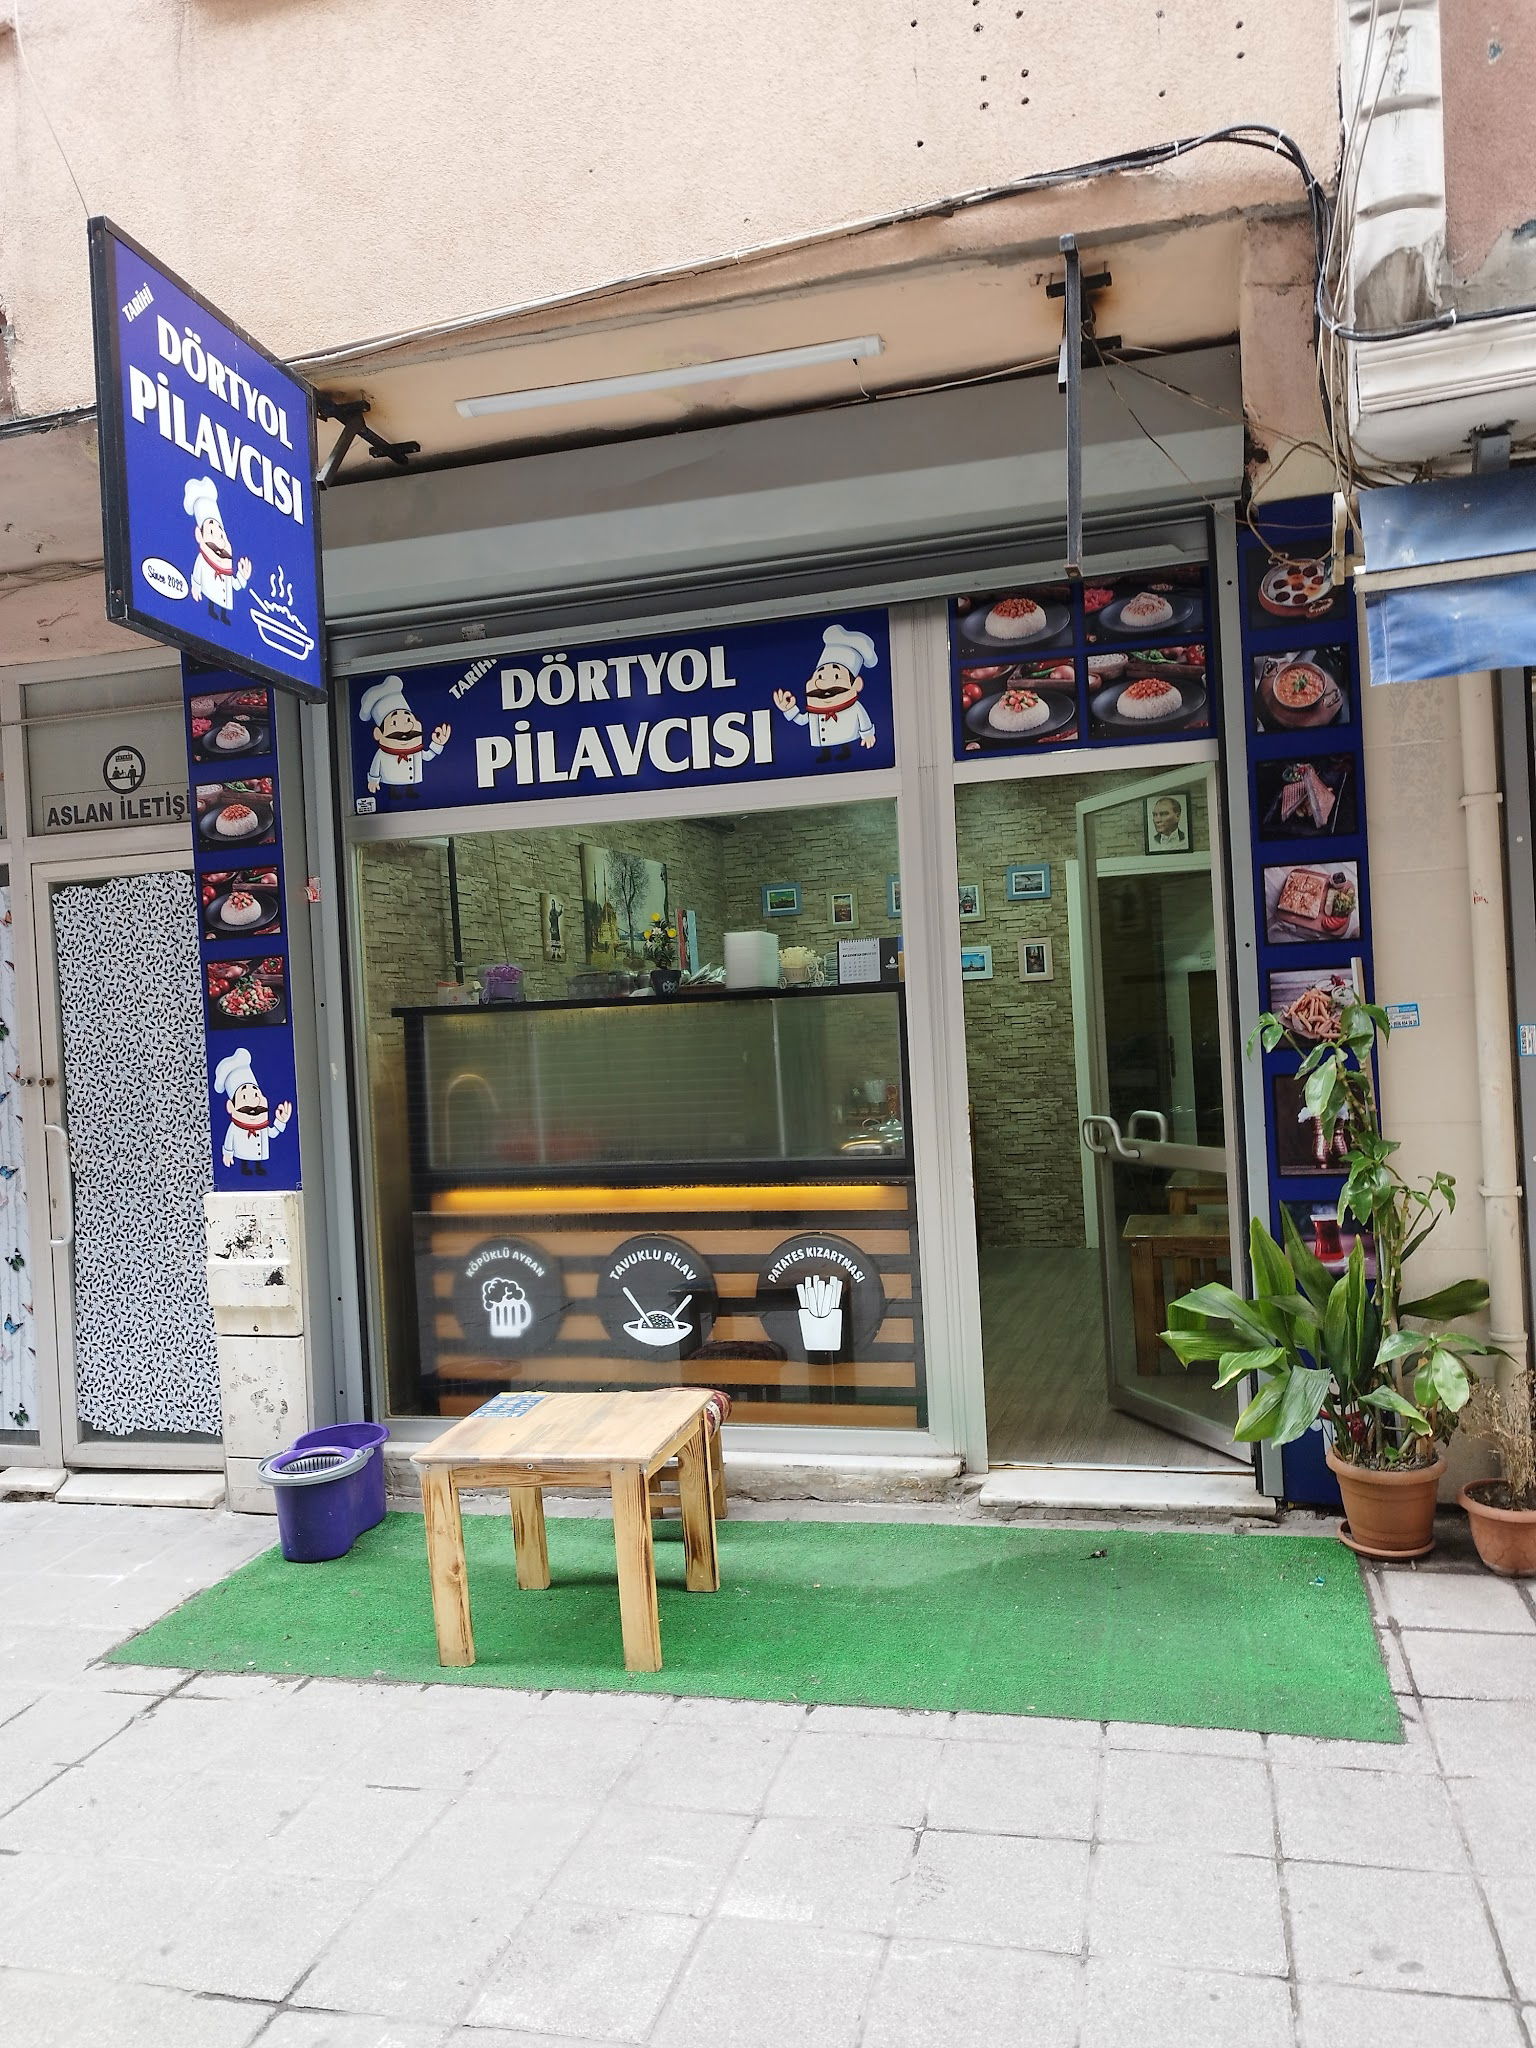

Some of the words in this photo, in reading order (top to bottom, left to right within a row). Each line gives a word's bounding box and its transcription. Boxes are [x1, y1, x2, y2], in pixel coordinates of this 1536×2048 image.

[121, 281, 155, 323] TARİHİ
[156, 314, 294, 451] DÖRTYOL
[128, 364, 304, 525] PİLAVCISI
[147, 564, 167, 584] Since
[167, 574, 184, 593] 2022
[500, 645, 737, 711] DÖRTYOL
[475, 709, 774, 789] PİLAVCISI
[47, 801, 114, 828] ASLAN
[465, 1246, 511, 1278] KÖPÜKLÜ
[512, 1250, 545, 1278] AYRAN
[609, 1249, 662, 1280] TAVUKLU
[663, 1252, 698, 1281] PİLAV
[767, 1248, 805, 1284] PATATES
[806, 1246, 866, 1284] KIZARTMASI
